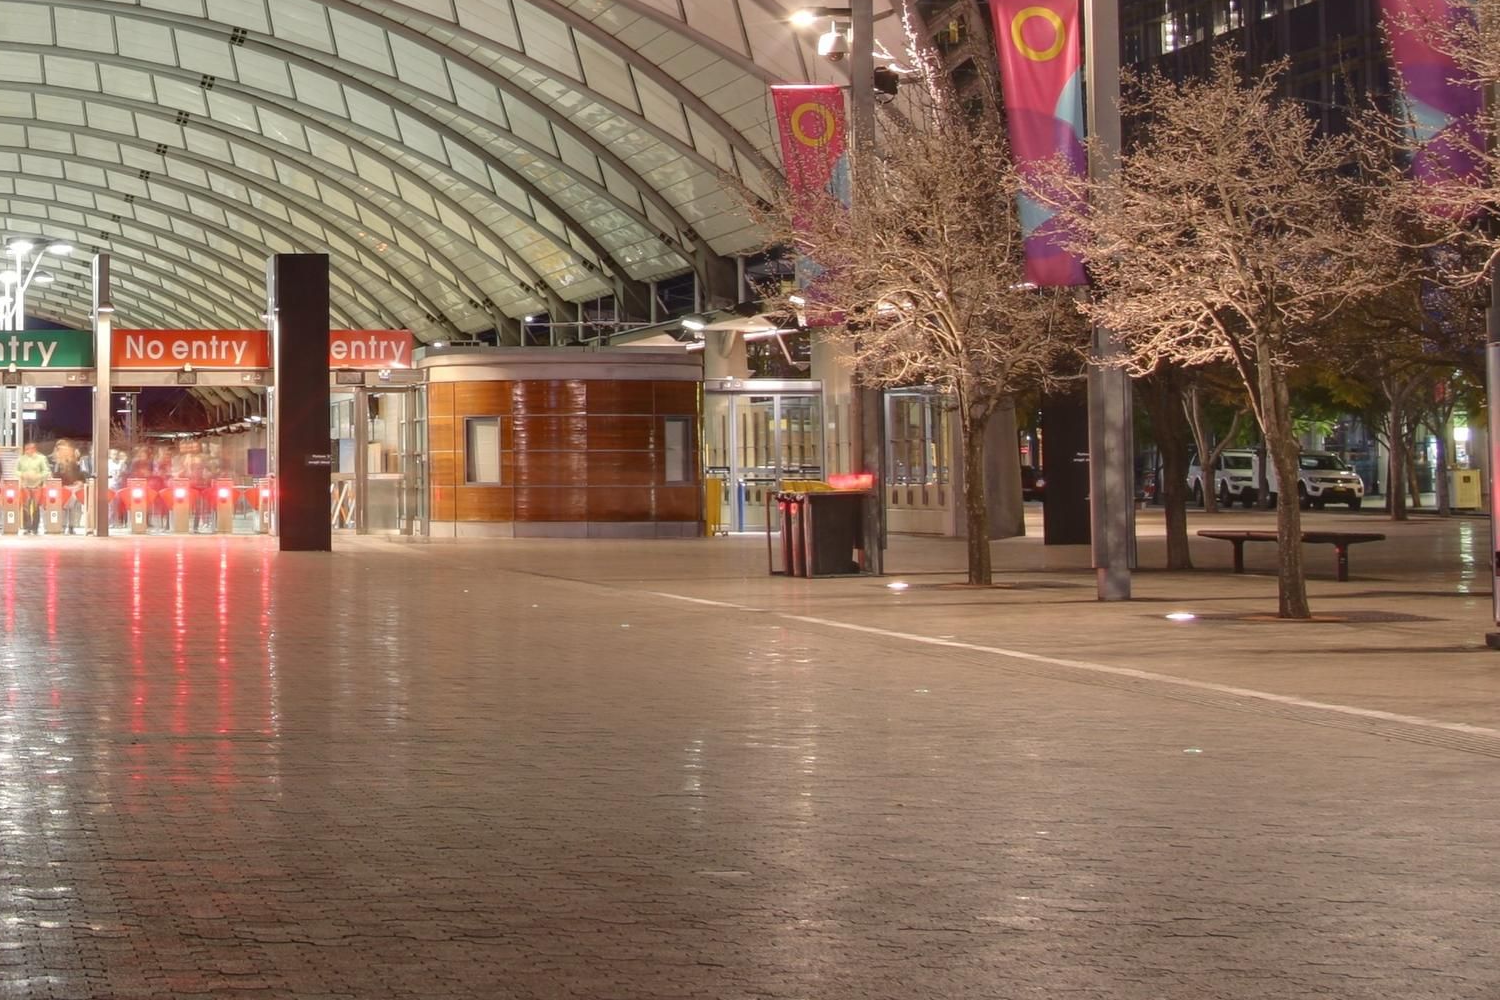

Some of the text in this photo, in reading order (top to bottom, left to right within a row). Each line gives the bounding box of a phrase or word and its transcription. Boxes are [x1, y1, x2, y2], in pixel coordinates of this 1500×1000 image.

[125, 335, 248, 365] No entry
[330, 335, 406, 364] entry
